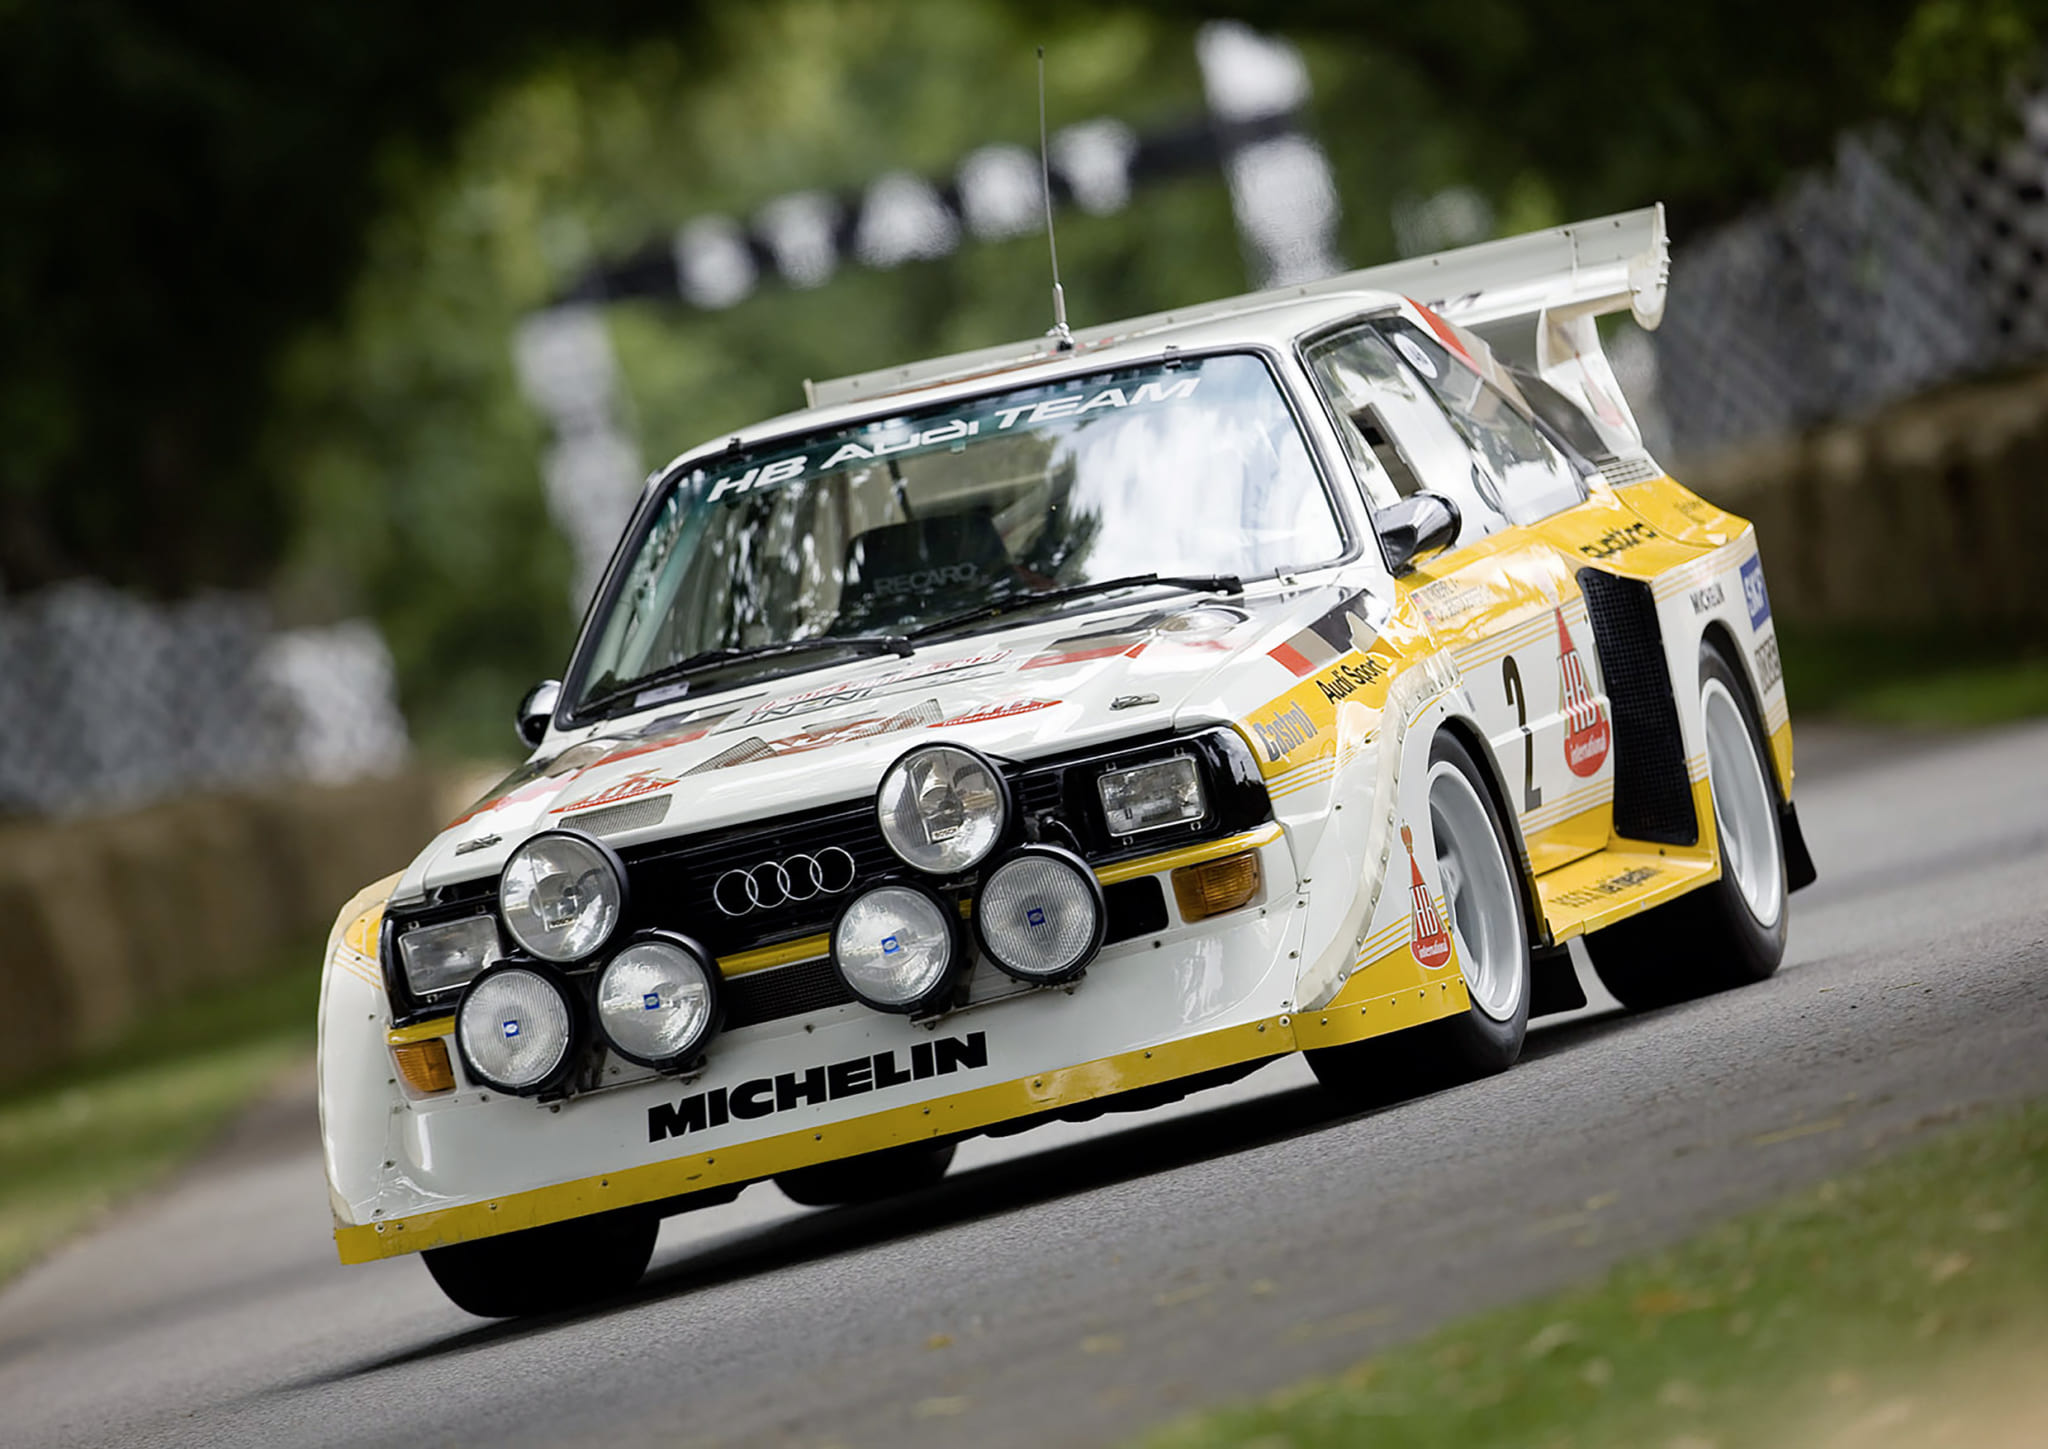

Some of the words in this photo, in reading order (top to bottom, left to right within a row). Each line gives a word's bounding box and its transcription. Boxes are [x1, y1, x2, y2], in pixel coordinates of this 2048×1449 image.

[706, 455, 808, 502] HB
[994, 378, 1200, 429] TEAM
[1580, 523, 1657, 558] quattro
[874, 562, 978, 596] RECARO
[1316, 669, 1357, 705] Audi
[1340, 656, 1388, 685] Sport
[1556, 651, 1597, 733] HB
[1253, 701, 1318, 762] Castrol
[1502, 655, 1541, 813] 2
[1410, 884, 1438, 938] HB
[647, 1030, 988, 1143] MICHELIN
